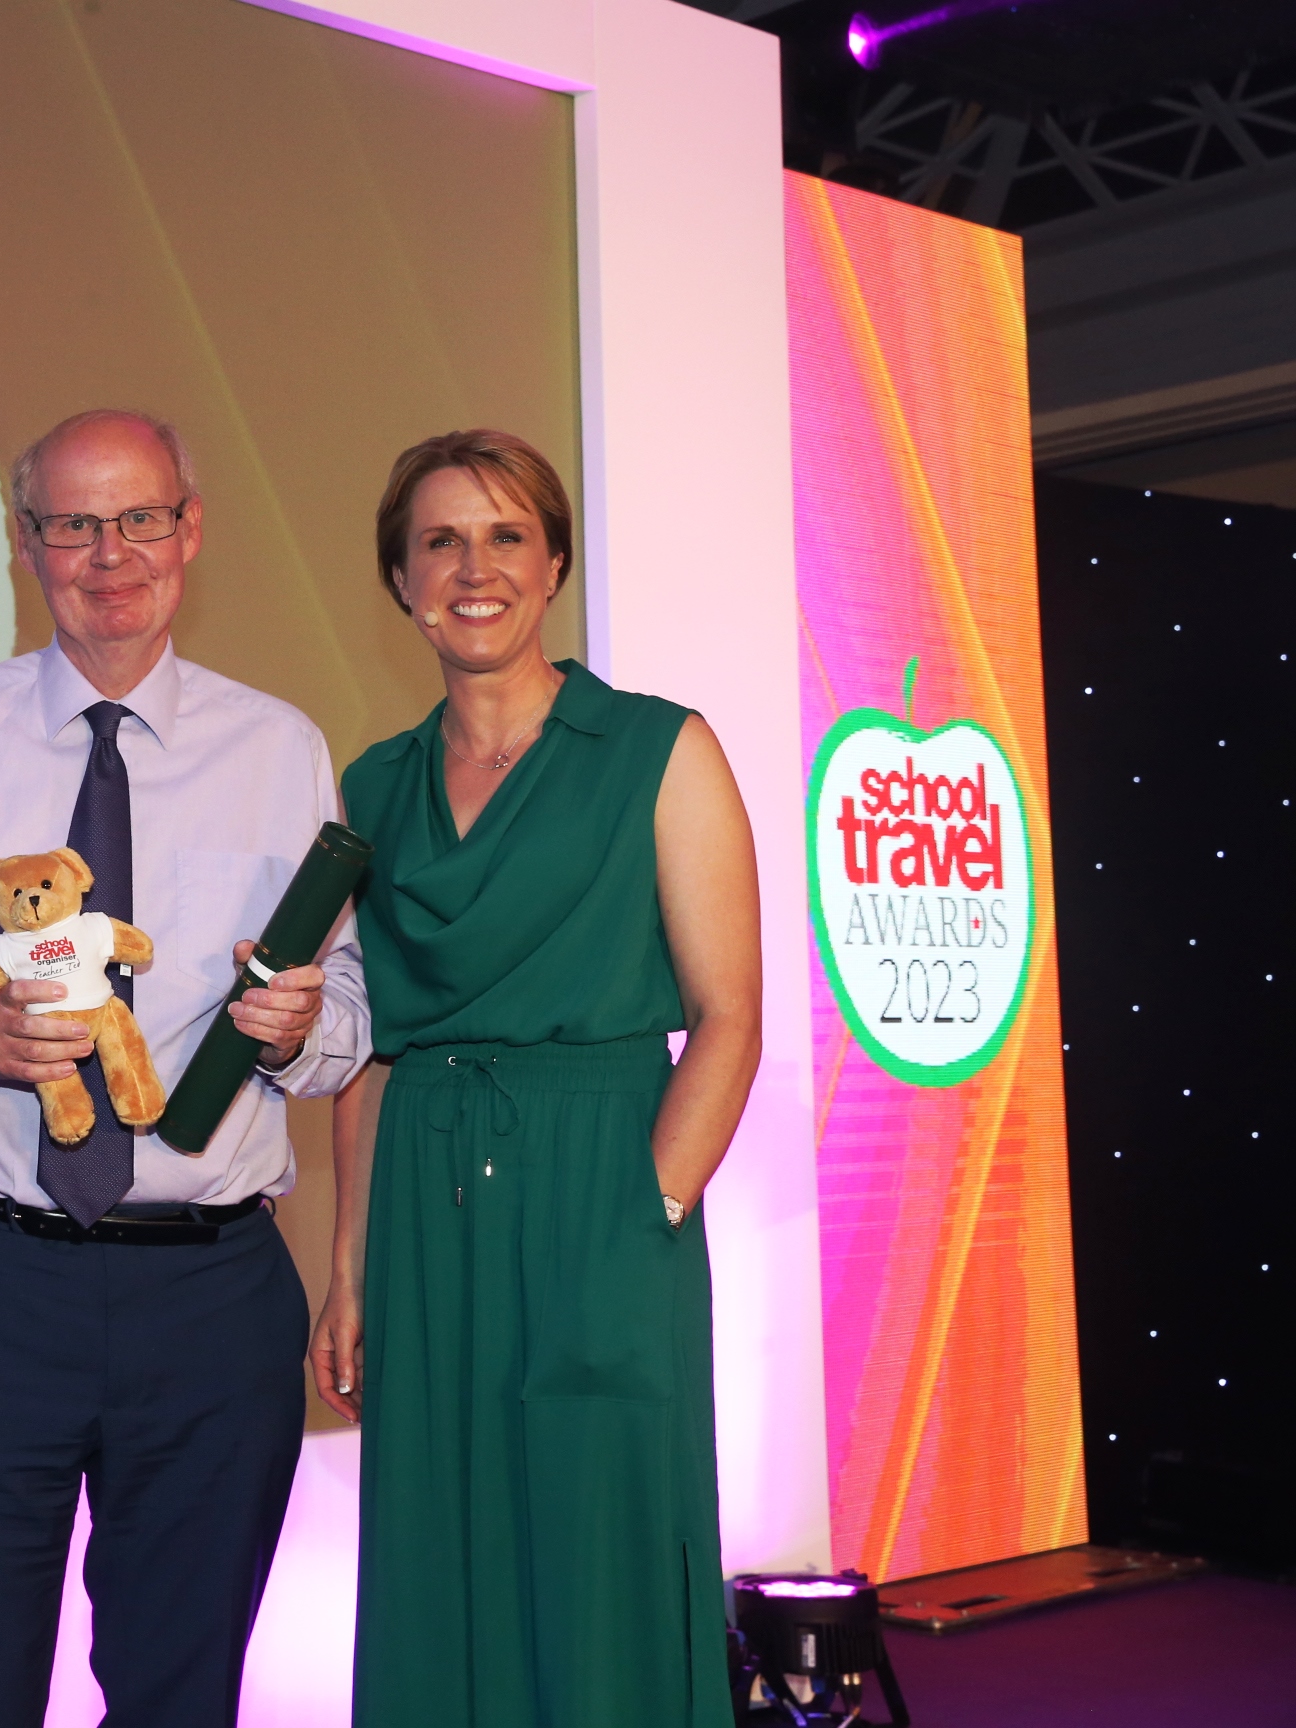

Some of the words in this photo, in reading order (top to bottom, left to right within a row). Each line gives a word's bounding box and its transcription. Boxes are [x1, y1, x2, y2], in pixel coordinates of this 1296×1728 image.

[860, 756, 987, 820] school
[837, 795, 1004, 890] travel
[844, 893, 1008, 948] AWARDS
[29, 941, 75, 961] travel
[35, 936, 69, 951] school
[37, 954, 76, 965] organiser
[33, 965, 63, 980] Teacher
[65, 958, 80, 971] Ted
[877, 958, 981, 1024] 2023
